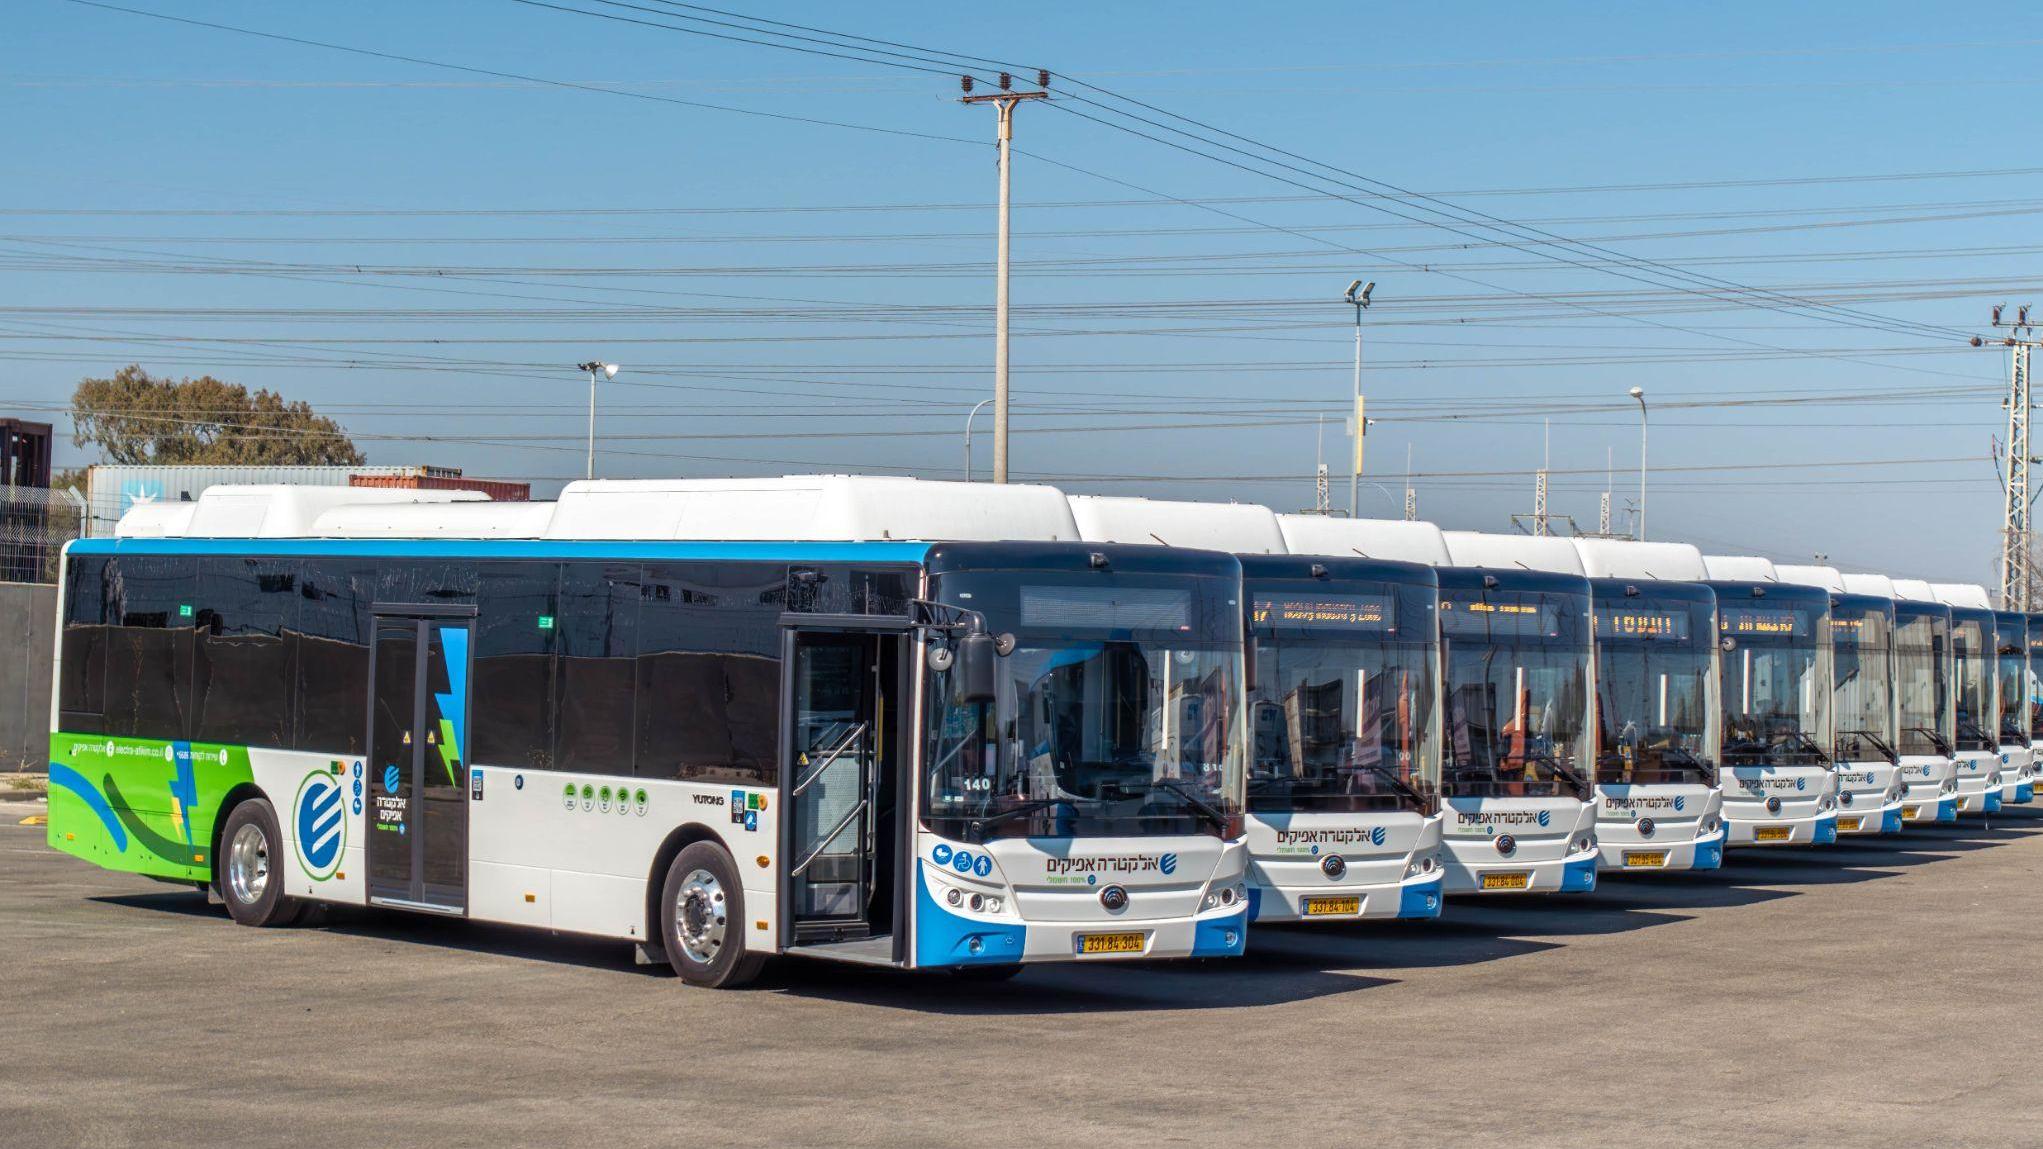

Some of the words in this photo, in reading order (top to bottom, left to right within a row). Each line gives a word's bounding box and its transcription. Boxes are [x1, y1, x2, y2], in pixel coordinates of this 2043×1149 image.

[963, 778, 990, 791] 140
[376, 795, 406, 810] אלקטרה
[692, 794, 725, 806] YUTONG
[1636, 796, 1674, 810] אלקטרה
[1458, 812, 1493, 826] אפיקים
[1494, 810, 1537, 826] אלקטרה
[1277, 830, 1318, 845] אפיקים
[1319, 828, 1371, 845] אלקטרה
[1046, 857, 1096, 875] אפיקים
[1097, 854, 1159, 874] אלקטרה
[1088, 936, 1105, 951] 331
